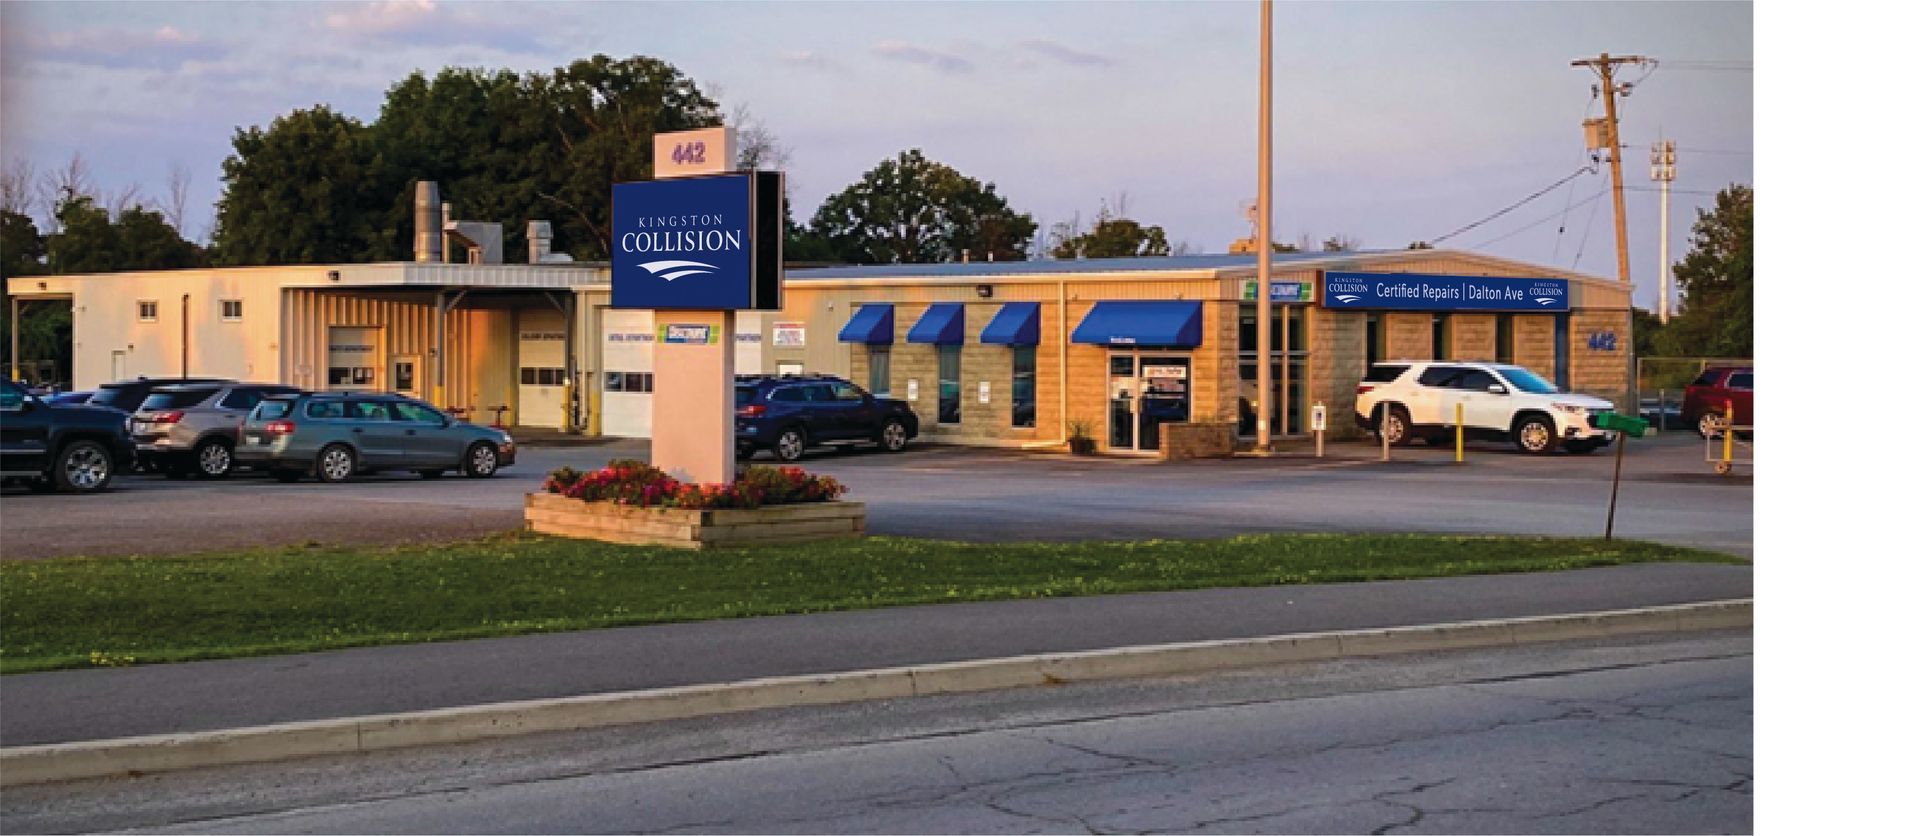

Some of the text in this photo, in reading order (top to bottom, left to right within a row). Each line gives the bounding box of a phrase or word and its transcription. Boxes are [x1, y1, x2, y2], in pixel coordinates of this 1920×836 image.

[671, 142, 706, 165] 442
[638, 214, 723, 228] KINGSTON
[621, 229, 742, 253] COLLISION
[1328, 283, 1368, 293] COLLISION
[1376, 282, 1420, 299] Certified
[1422, 283, 1460, 302] Repairs
[1468, 284, 1501, 300] Dalton
[1504, 285, 1524, 301] Ave
[1529, 287, 1563, 296] COLLISION
